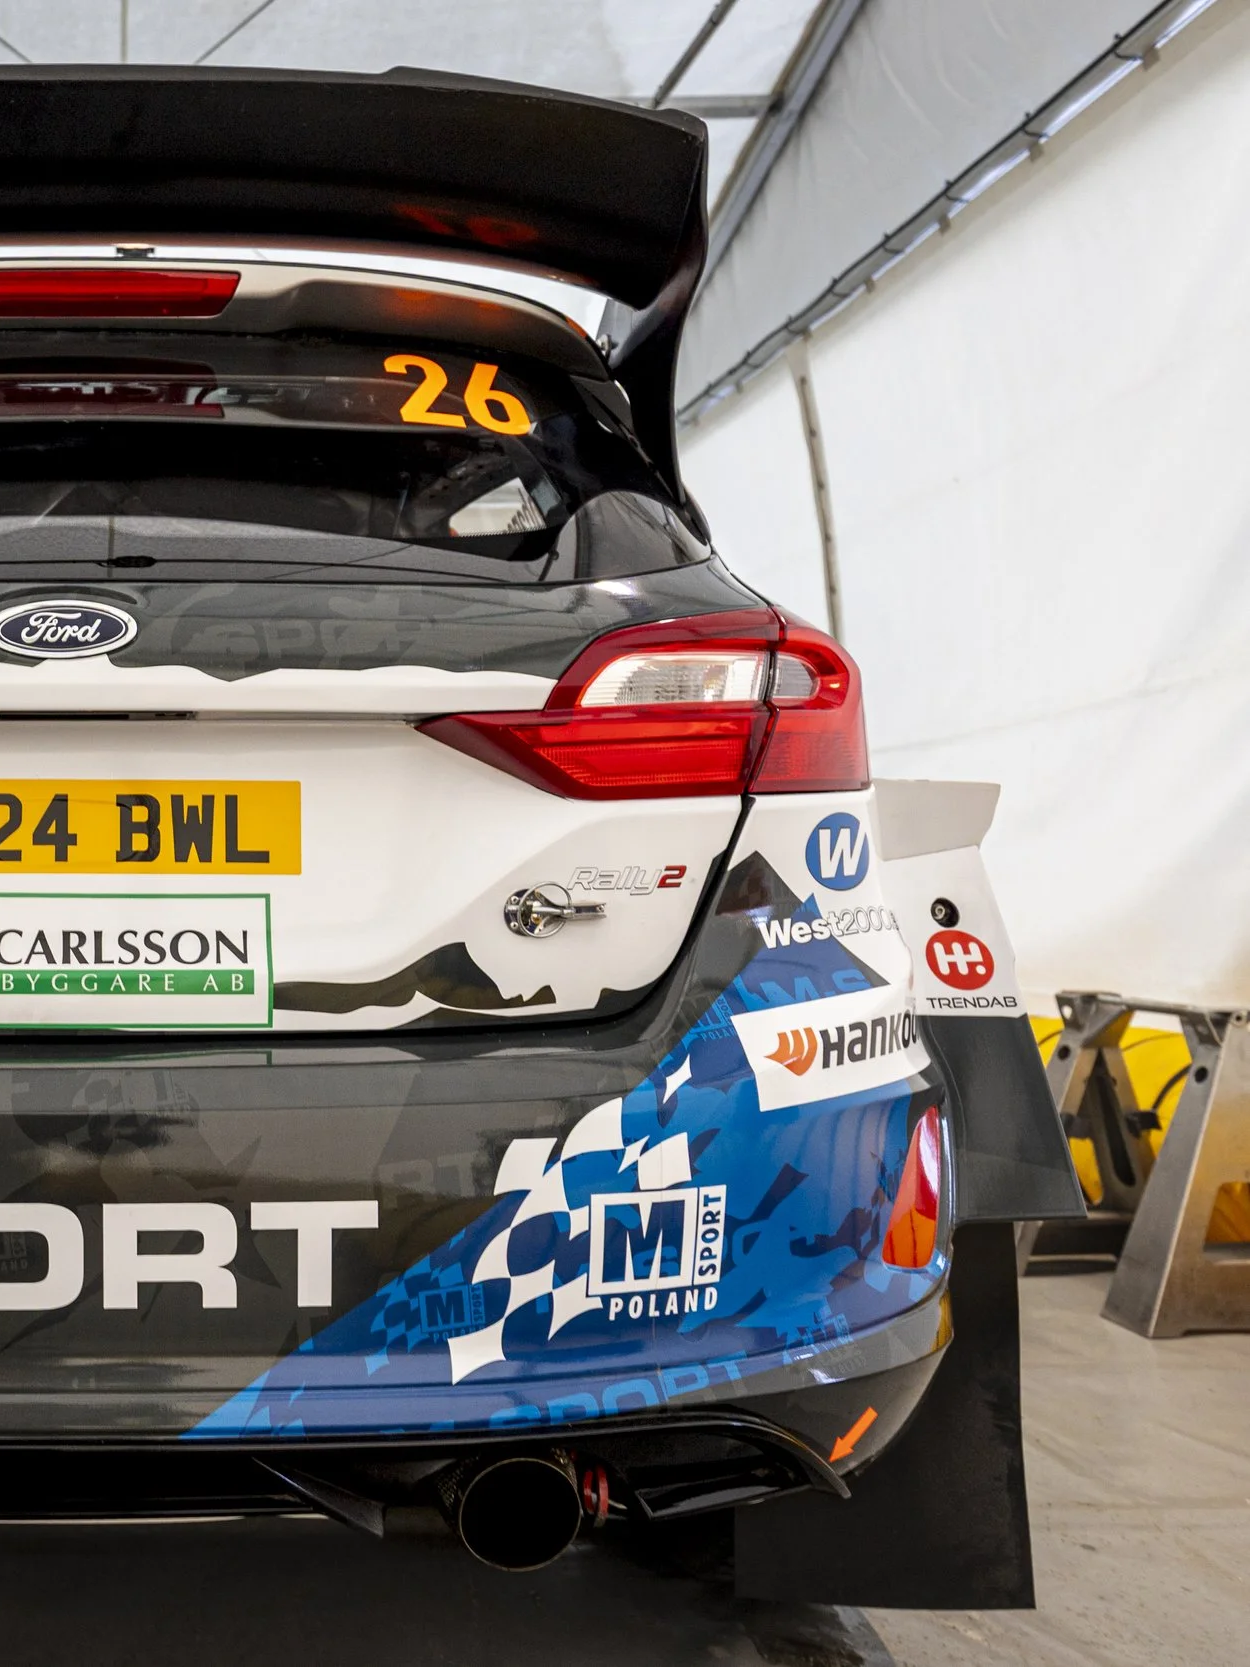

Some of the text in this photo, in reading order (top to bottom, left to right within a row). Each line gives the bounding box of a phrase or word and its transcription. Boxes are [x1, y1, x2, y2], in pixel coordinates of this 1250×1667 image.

[383, 354, 533, 435] 26
[20, 612, 102, 644] Ford
[116, 794, 270, 863] BWL
[818, 823, 866, 879] W
[567, 865, 687, 895] Rally2
[2, 973, 244, 993] BYGGARE AB
[926, 996, 1018, 1009] TRENDAB
[602, 1199, 685, 1283] M
[698, 1194, 722, 1277] SPORT
[609, 1286, 719, 1321] POLAND
